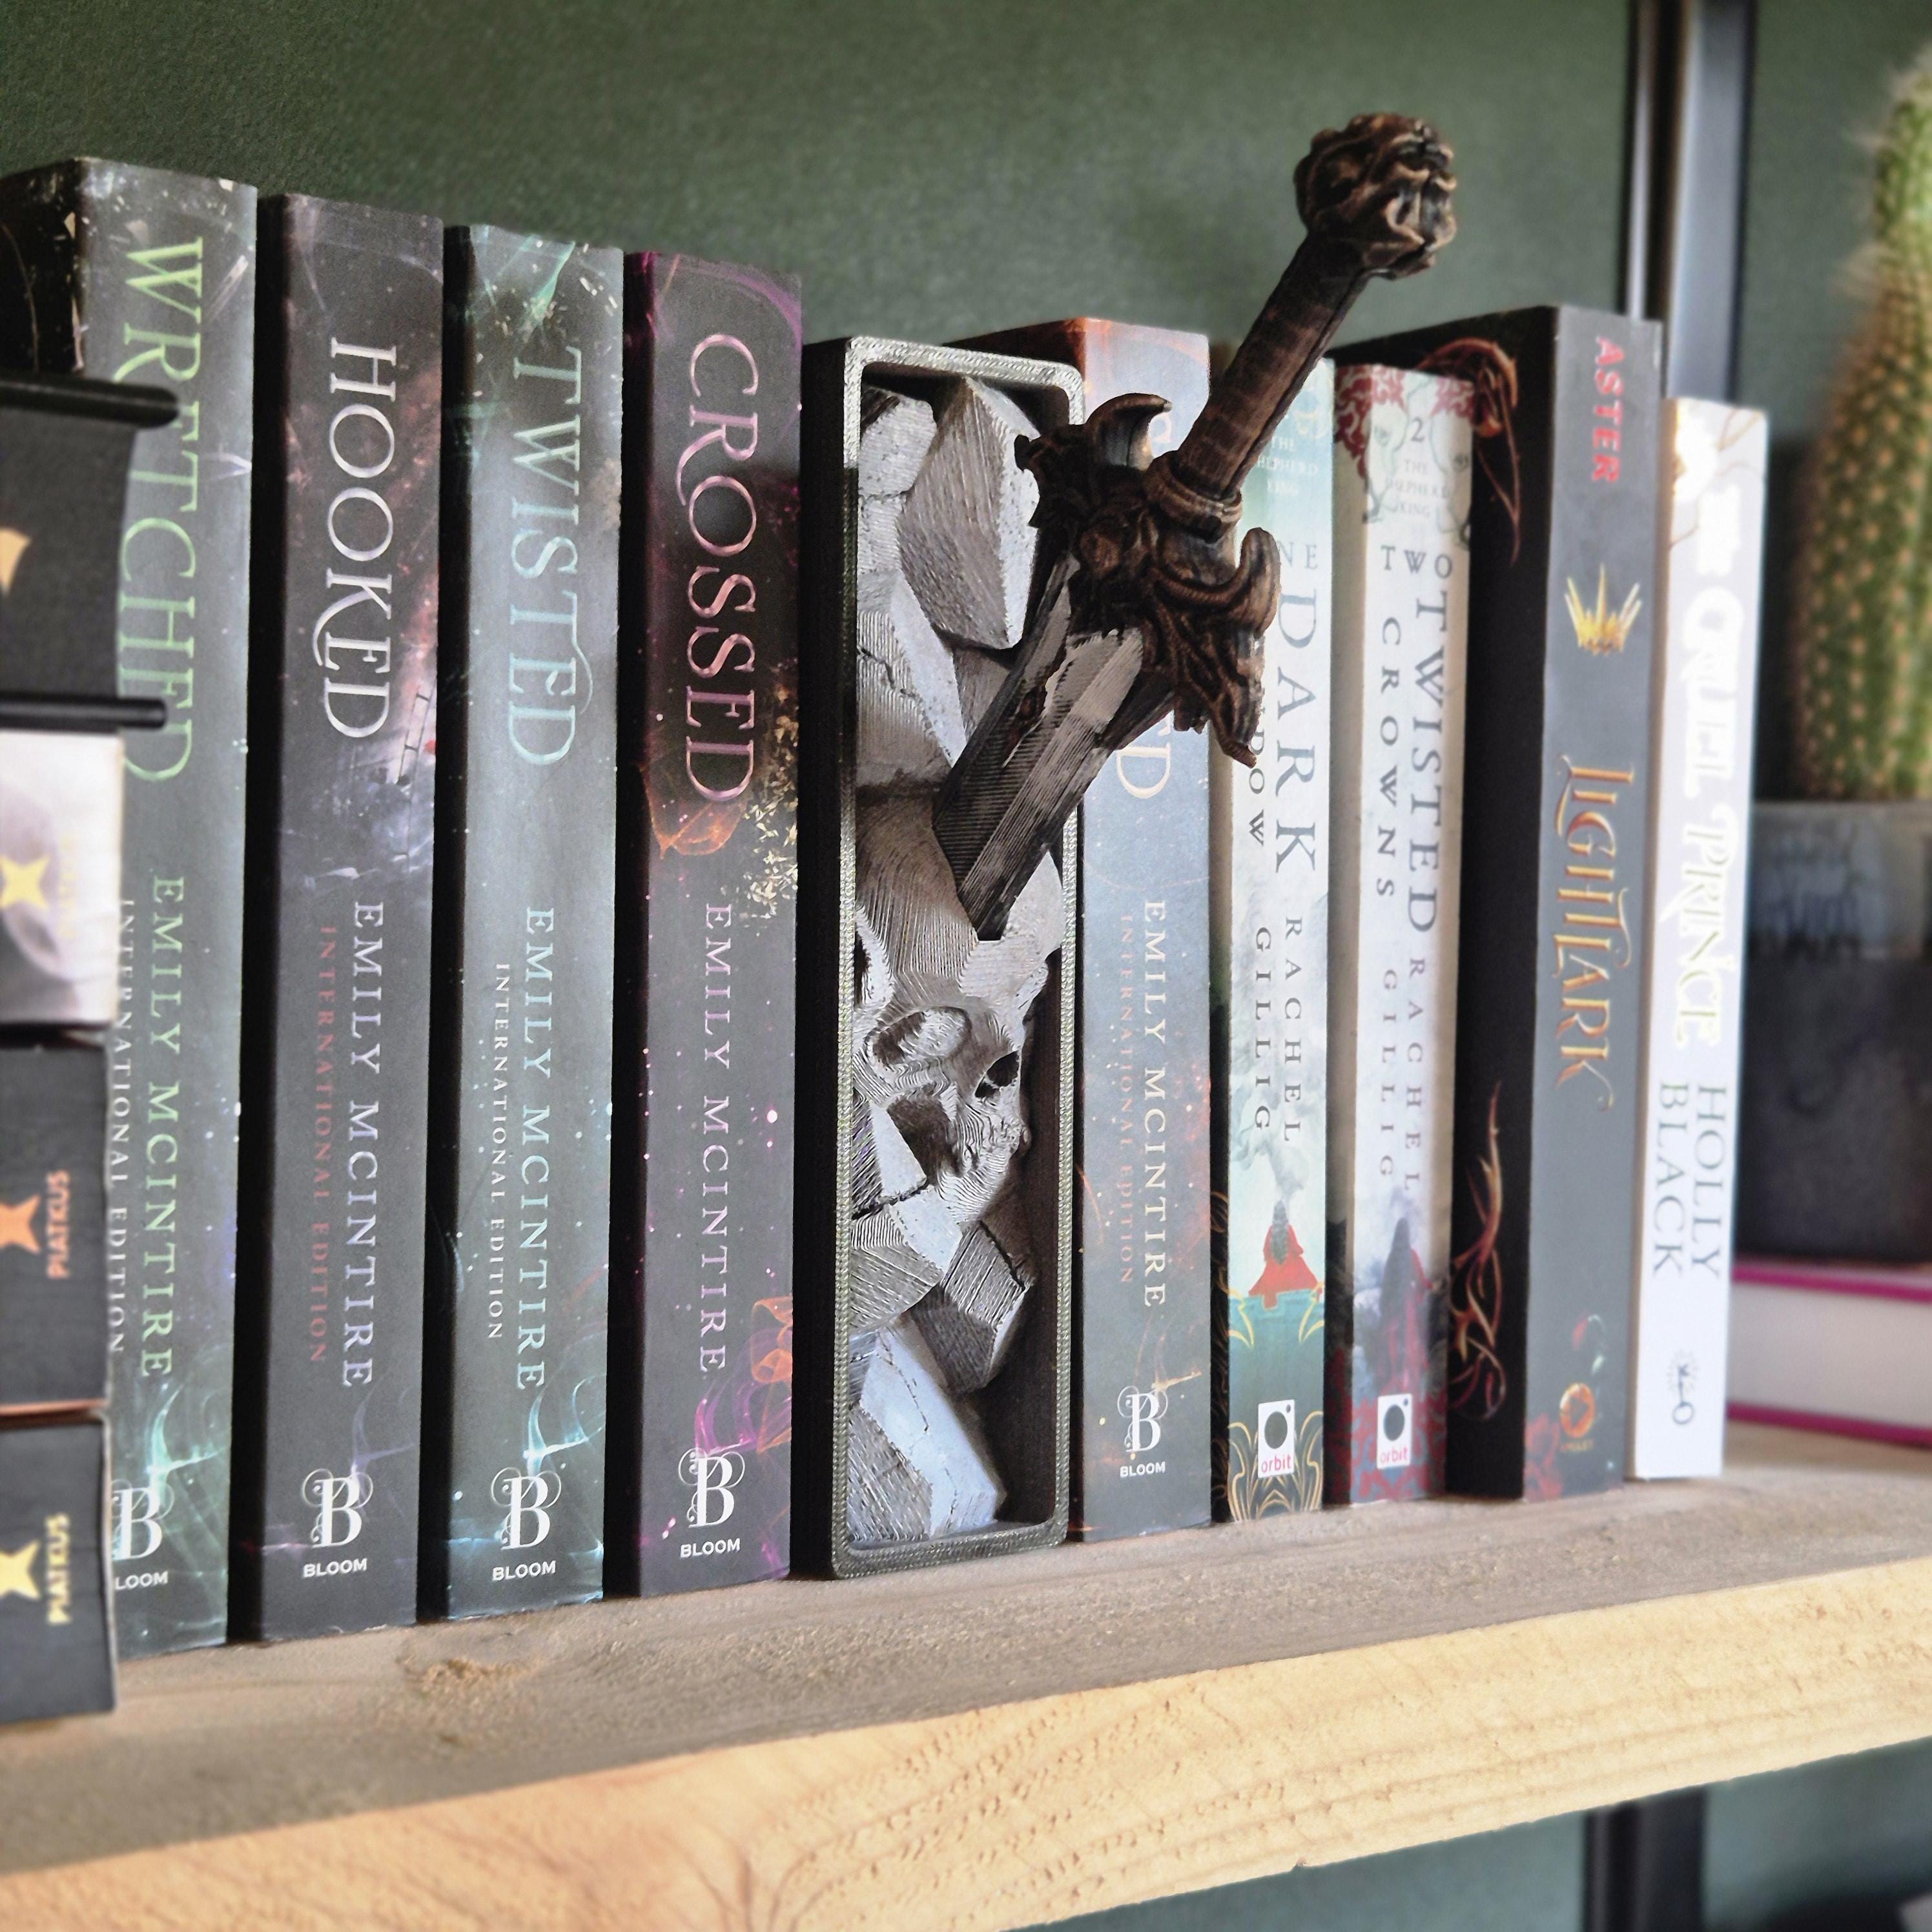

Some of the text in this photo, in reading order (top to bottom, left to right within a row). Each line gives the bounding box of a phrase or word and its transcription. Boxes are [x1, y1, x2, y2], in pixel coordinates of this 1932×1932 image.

[1257, 457, 1319, 477] HEPHERD
[1411, 416, 1426, 442] 2
[1592, 336, 1625, 484] ASTER
[313, 336, 396, 738] HOOKED
[508, 345, 593, 766] TWISTED
[677, 334, 759, 802] CROSSED
[1277, 540, 1320, 570] NE
[1380, 544, 1453, 581] TWO
[1275, 587, 1318, 874] DARK
[1377, 616, 1402, 897] CROWNS
[1408, 589, 1447, 933] TWISTED
[1255, 927, 1272, 1129] GILLIG
[1283, 916, 1303, 1142] RACHEL
[1552, 754, 1635, 1112] LIGHTLARK
[107, 899, 135, 1353] INTERNATIONAL EDITION
[141, 875, 185, 1377] EMILY MCINTIRE
[309, 926, 336, 1361] INTERNATIONAL EDITION
[343, 901, 384, 1388] EMILY MCINTIRE
[488, 963, 510, 1339] INTERNATIONAL EDITION
[517, 907, 554, 1390] EMILY MCINTIRE
[700, 903, 732, 1373] EMILY MCINTIRE
[1144, 899, 1166, 1308] EMILY MCINTIRE
[1380, 969, 1397, 1177] GILLIG
[1406, 957, 1426, 1191] RACHEL
[1652, 1080, 1690, 1279] BLACK
[1690, 1084, 1727, 1280] HOLLY
[302, 1557, 368, 1578] BLOOM
[680, 1537, 741, 1558] BLOOM
[1120, 1461, 1166, 1477] BLOOM
[1260, 1455, 1293, 1474] orbit
[1379, 1446, 1408, 1464] orbit
[114, 1570, 169, 1590] LOOM
[492, 1559, 557, 1581] BLOOM
